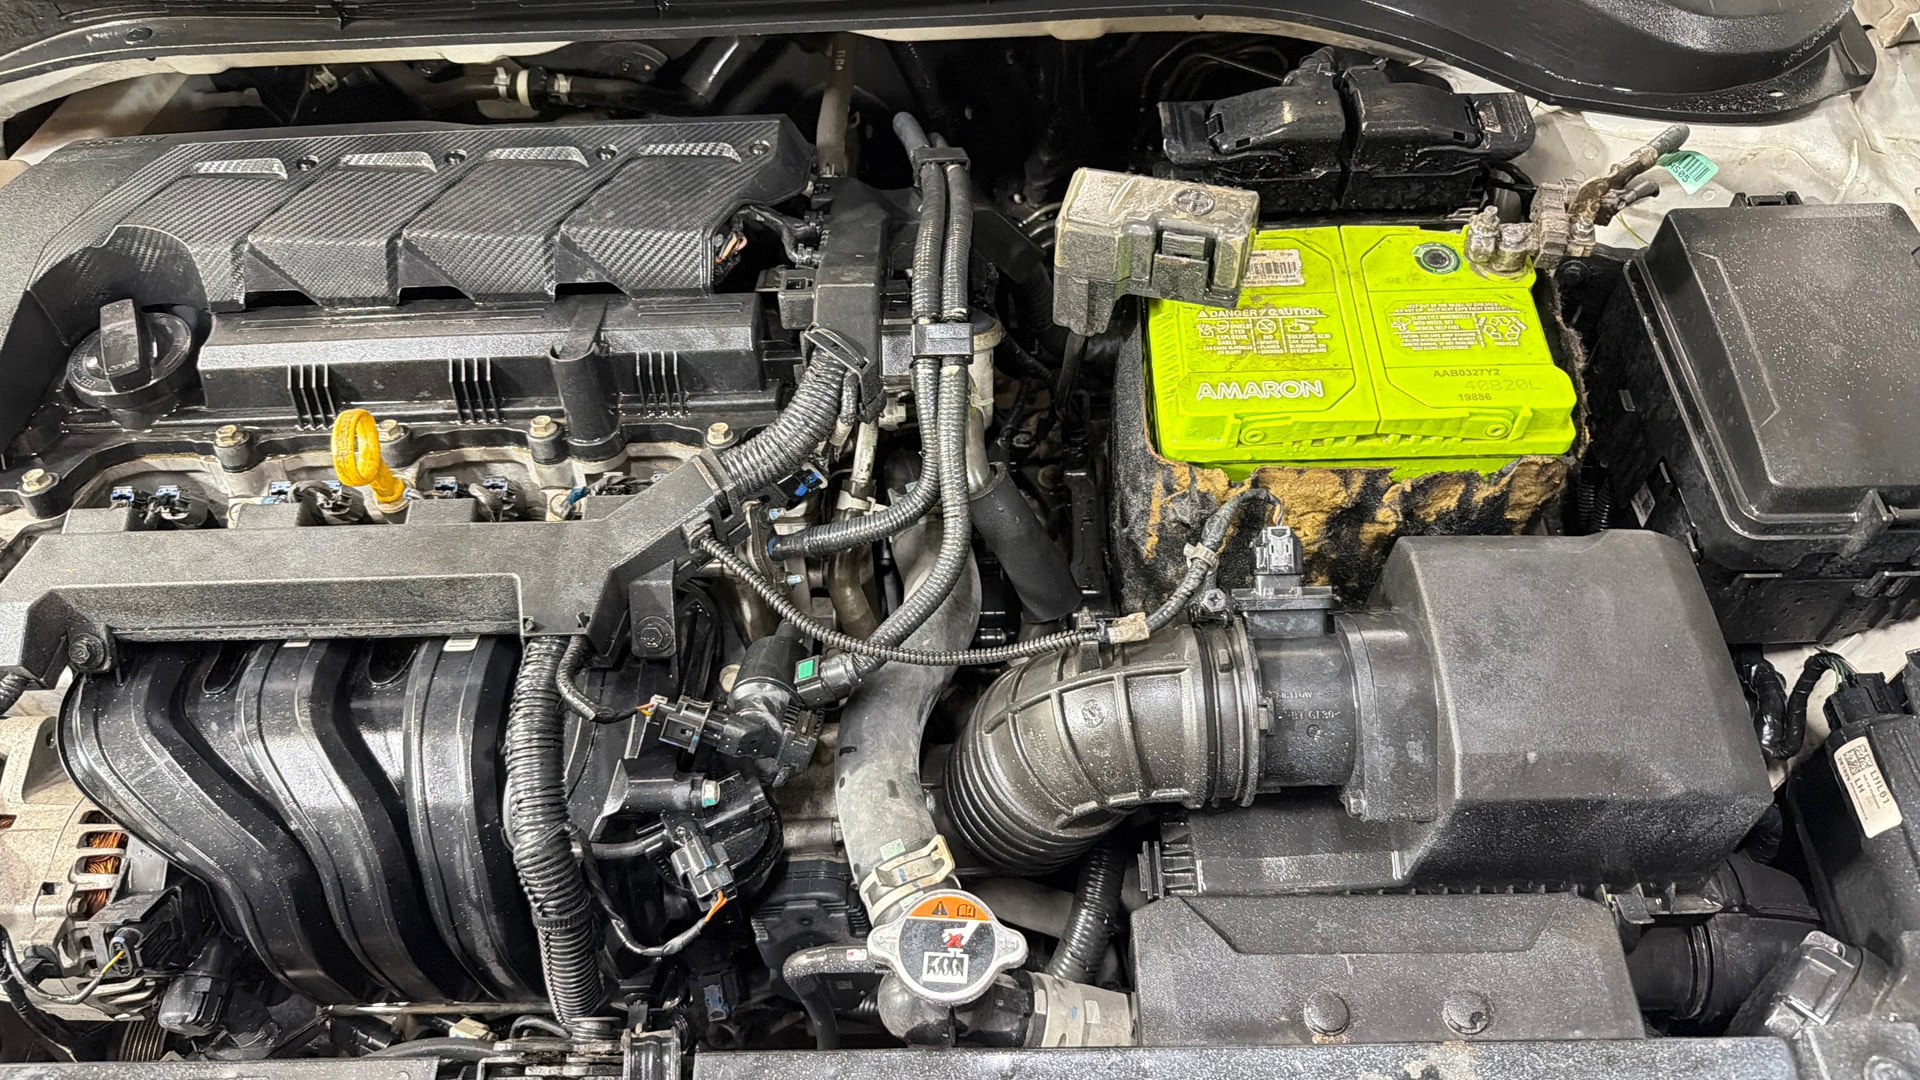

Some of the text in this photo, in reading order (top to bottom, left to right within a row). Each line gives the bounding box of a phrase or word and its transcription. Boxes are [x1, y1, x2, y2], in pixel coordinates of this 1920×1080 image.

[1210, 309, 1258, 318] DANGER
[1268, 308, 1320, 316] CAUTION
[1433, 368, 1501, 377] AAB0327Y2
[1196, 379, 1324, 400] AMARON
[1465, 379, 1542, 391] 40B20L
[1458, 393, 1492, 401] 19886
[1854, 778, 1865, 793] LH
